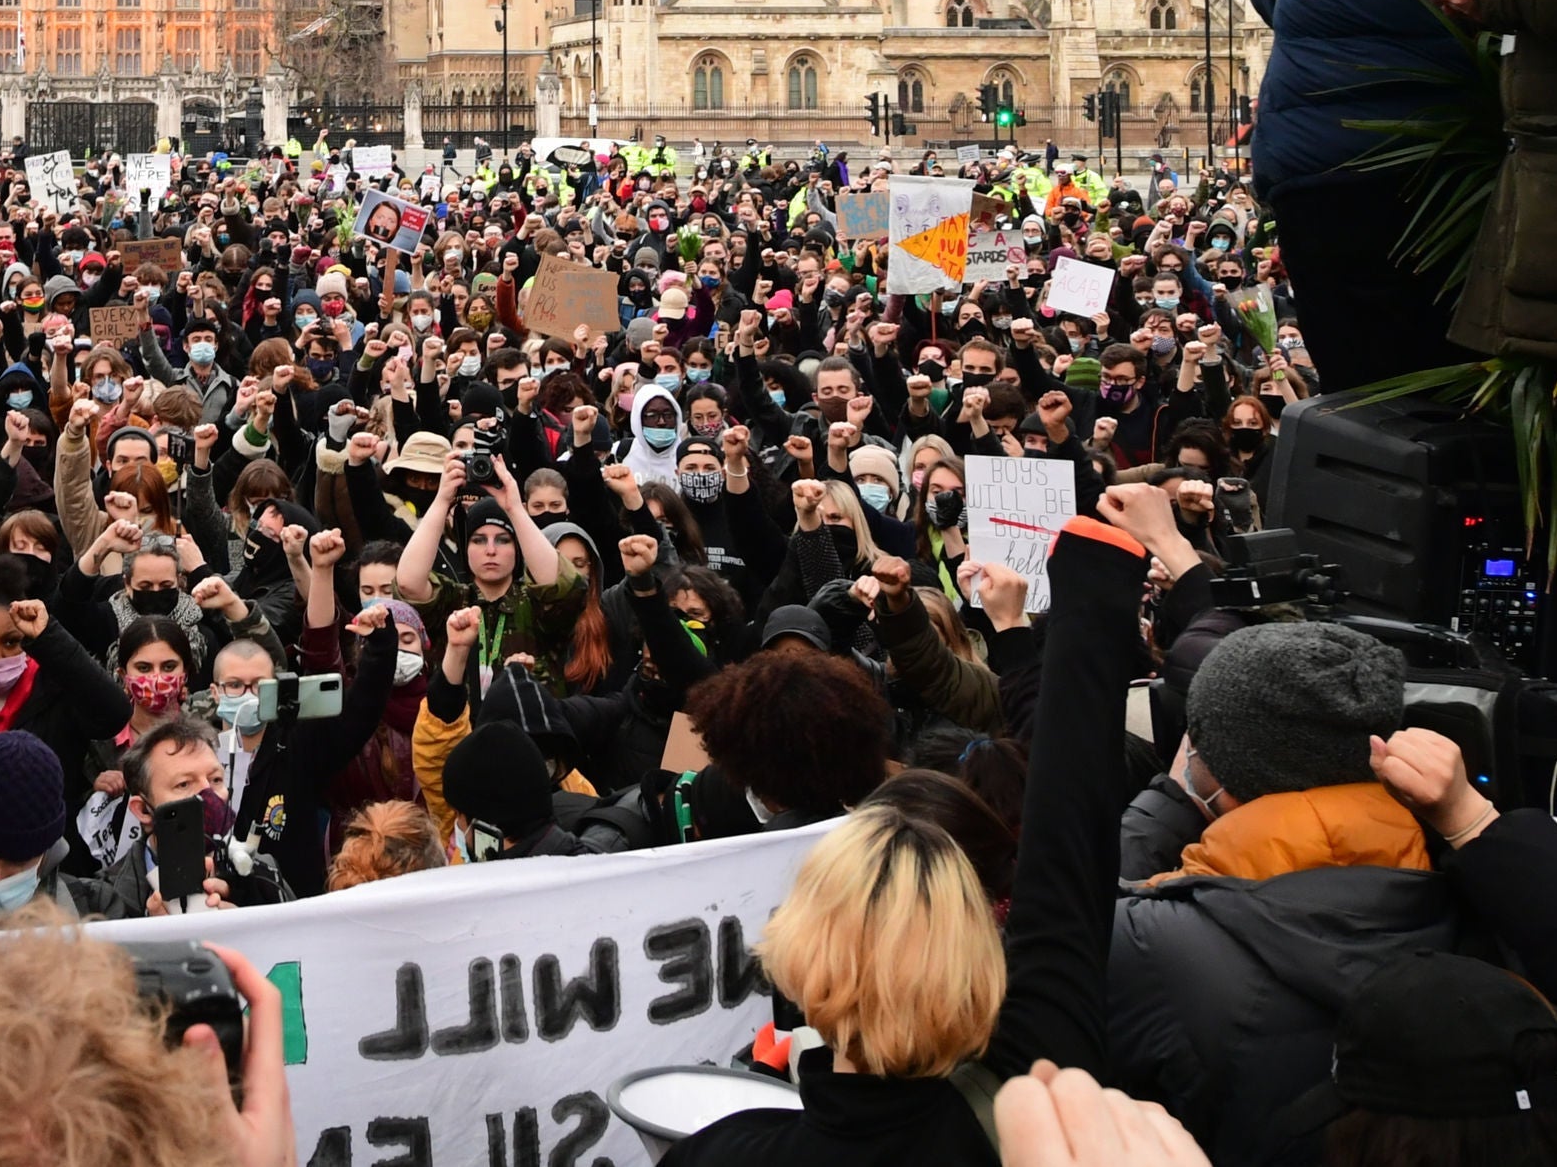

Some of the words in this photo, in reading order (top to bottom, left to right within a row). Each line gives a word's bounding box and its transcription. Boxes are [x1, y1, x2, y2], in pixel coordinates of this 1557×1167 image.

[132, 155, 155, 170] WE
[128, 170, 166, 181] WERE
[966, 249, 1007, 265] STARDS
[1056, 274, 1101, 301] ACAB
[92, 308, 137, 323] EVERY
[94, 323, 123, 336] GIRL
[682, 472, 720, 487] ABOLISH
[992, 458, 1048, 485] BOYS
[967, 484, 1027, 512] WILL
[1044, 487, 1074, 516] BE
[993, 511, 1051, 542] BOYS
[1005, 540, 1049, 576] held
